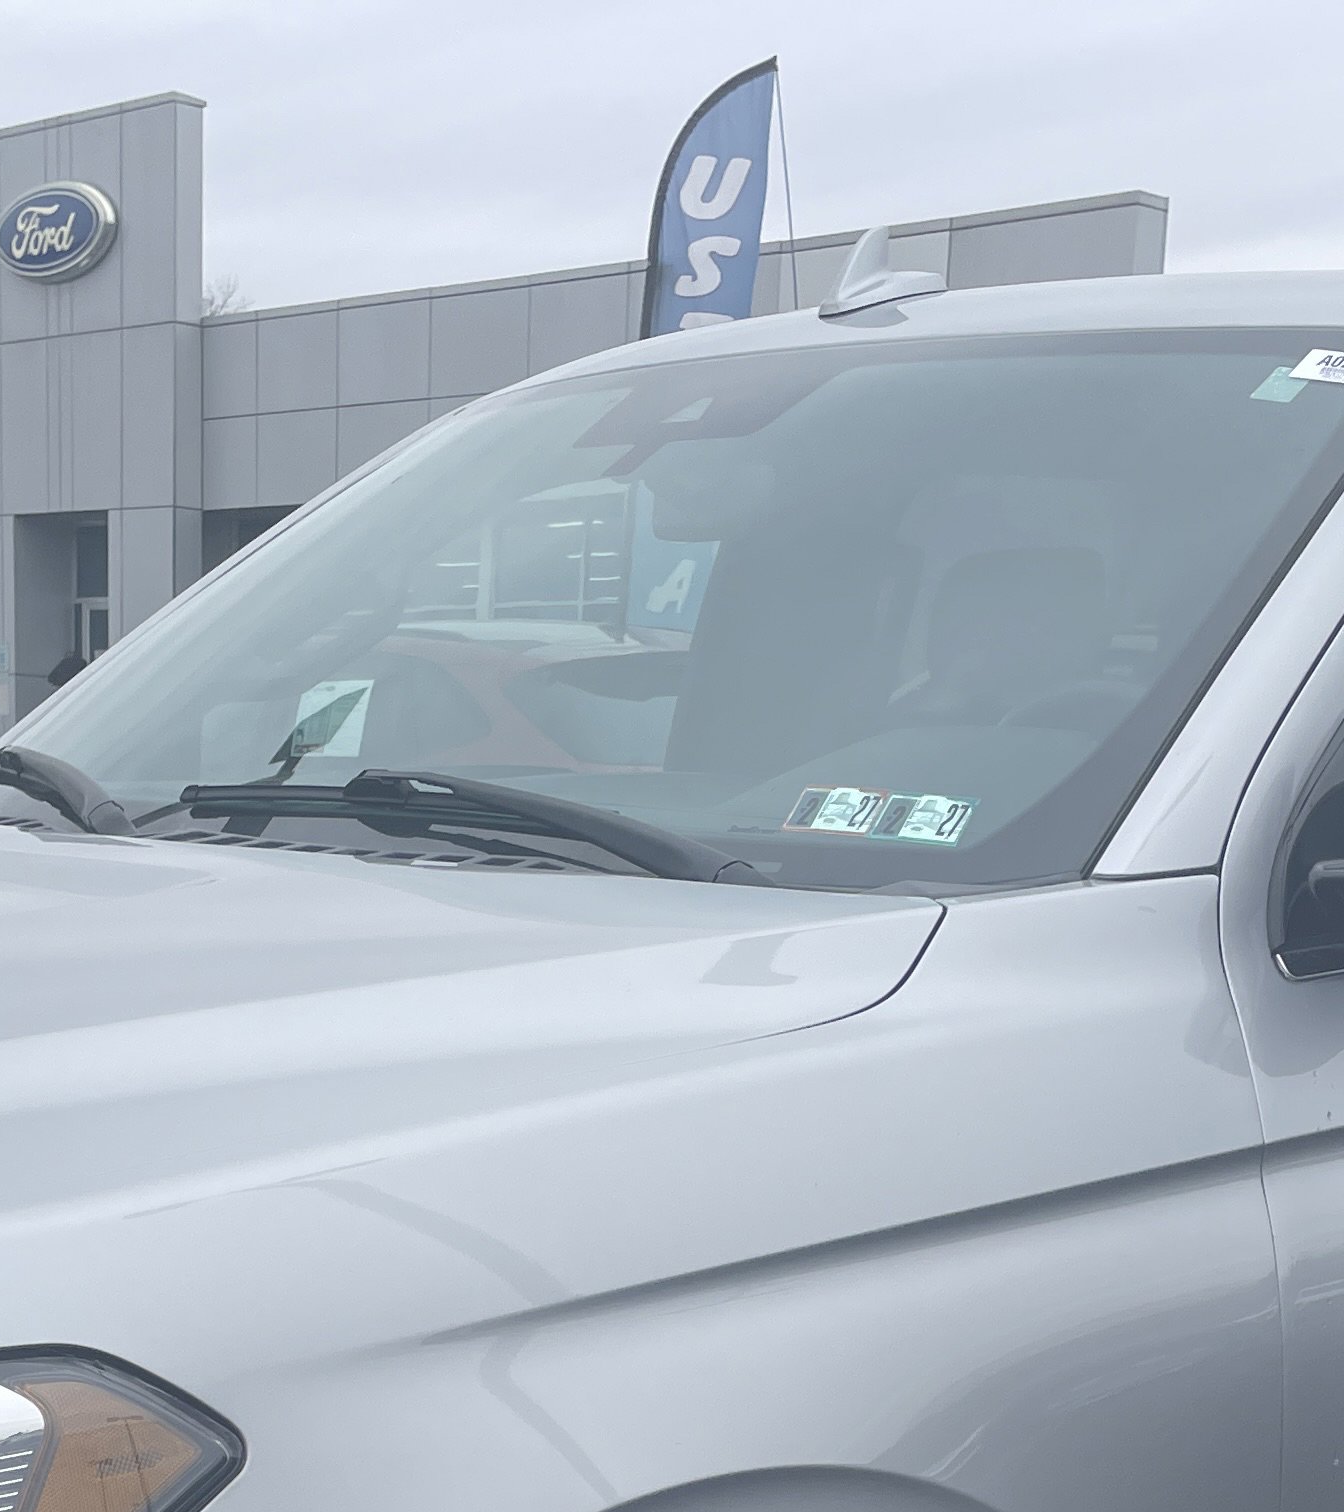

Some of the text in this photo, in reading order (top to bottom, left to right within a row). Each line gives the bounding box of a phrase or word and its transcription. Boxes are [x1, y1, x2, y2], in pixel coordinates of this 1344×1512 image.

[10, 203, 76, 260] Ford
[674, 154, 753, 331] US
[847, 795, 882, 831] 27
[935, 803, 972, 840] 27
